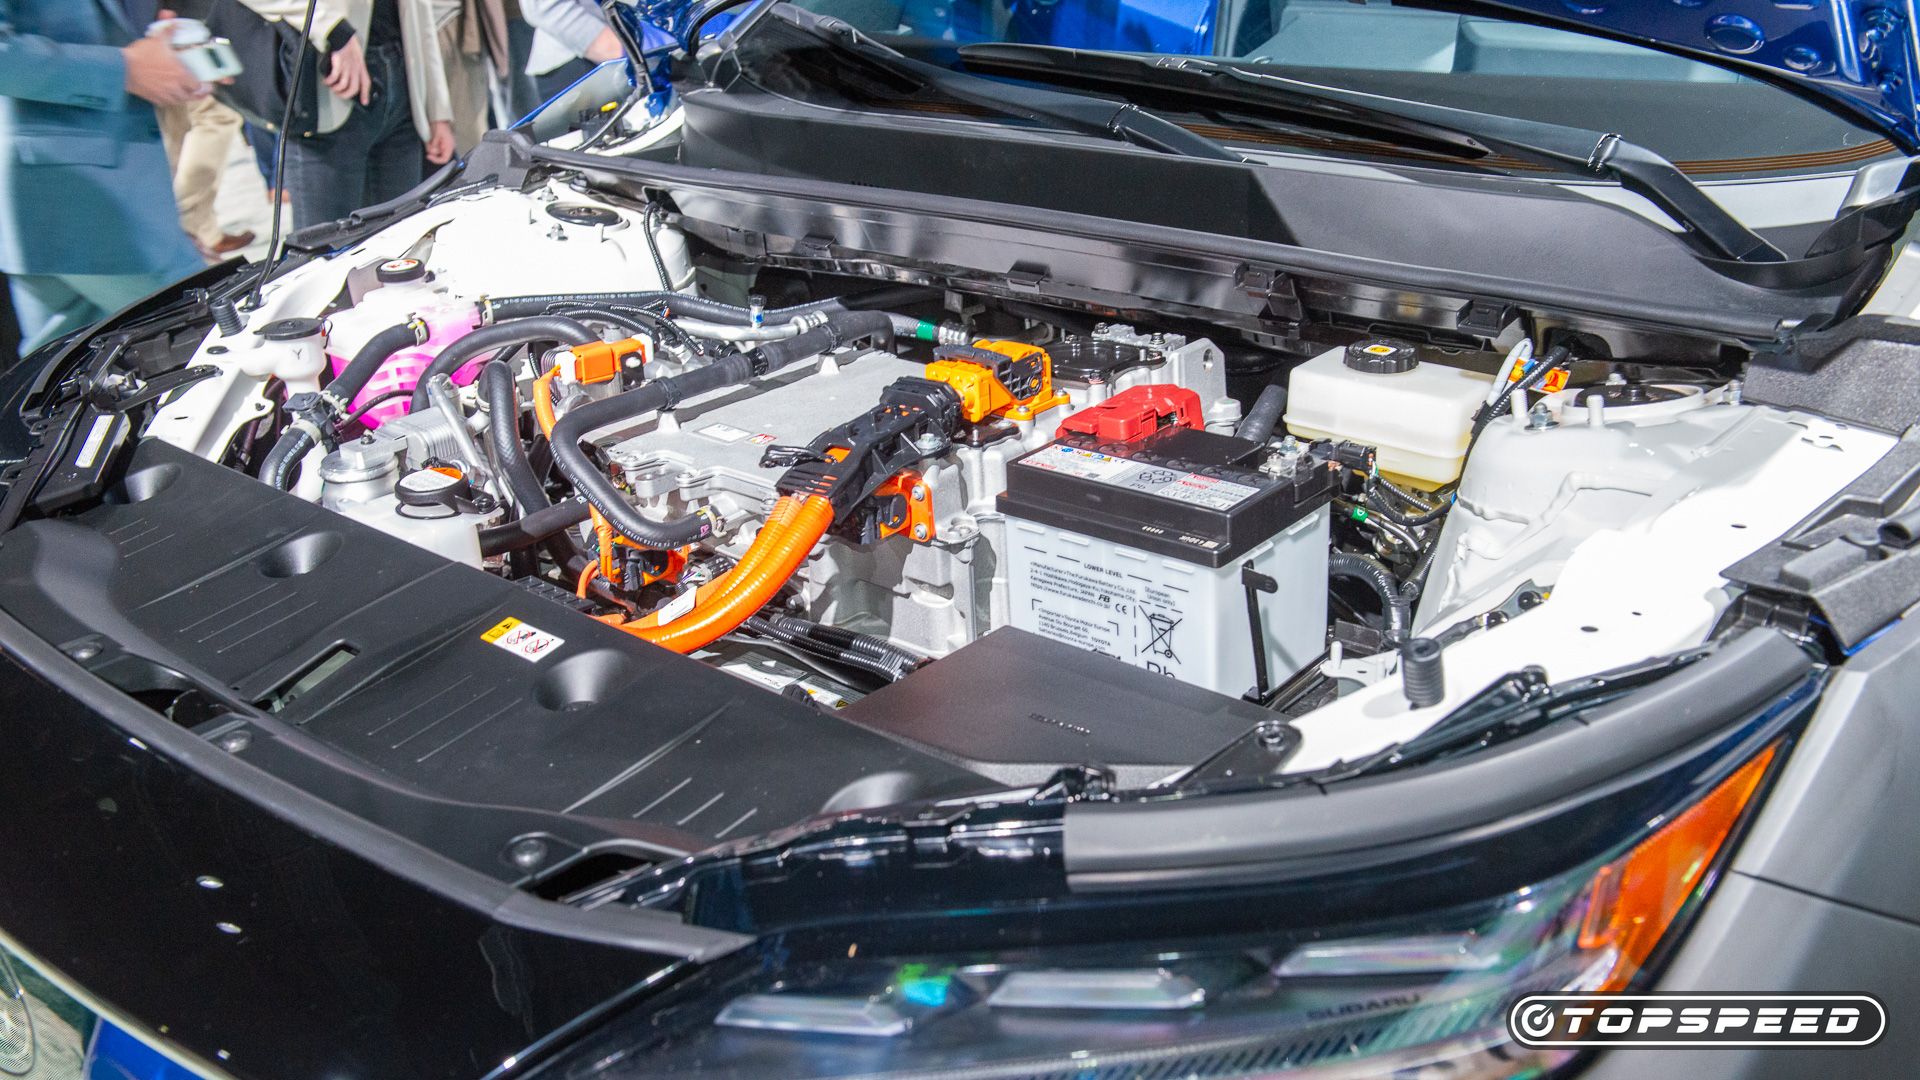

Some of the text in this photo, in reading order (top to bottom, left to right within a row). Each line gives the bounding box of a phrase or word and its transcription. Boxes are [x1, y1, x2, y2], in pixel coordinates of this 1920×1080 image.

[1083, 563, 1123, 578] LOWER LEVEL
[1091, 636, 1110, 646] TOYOTA
